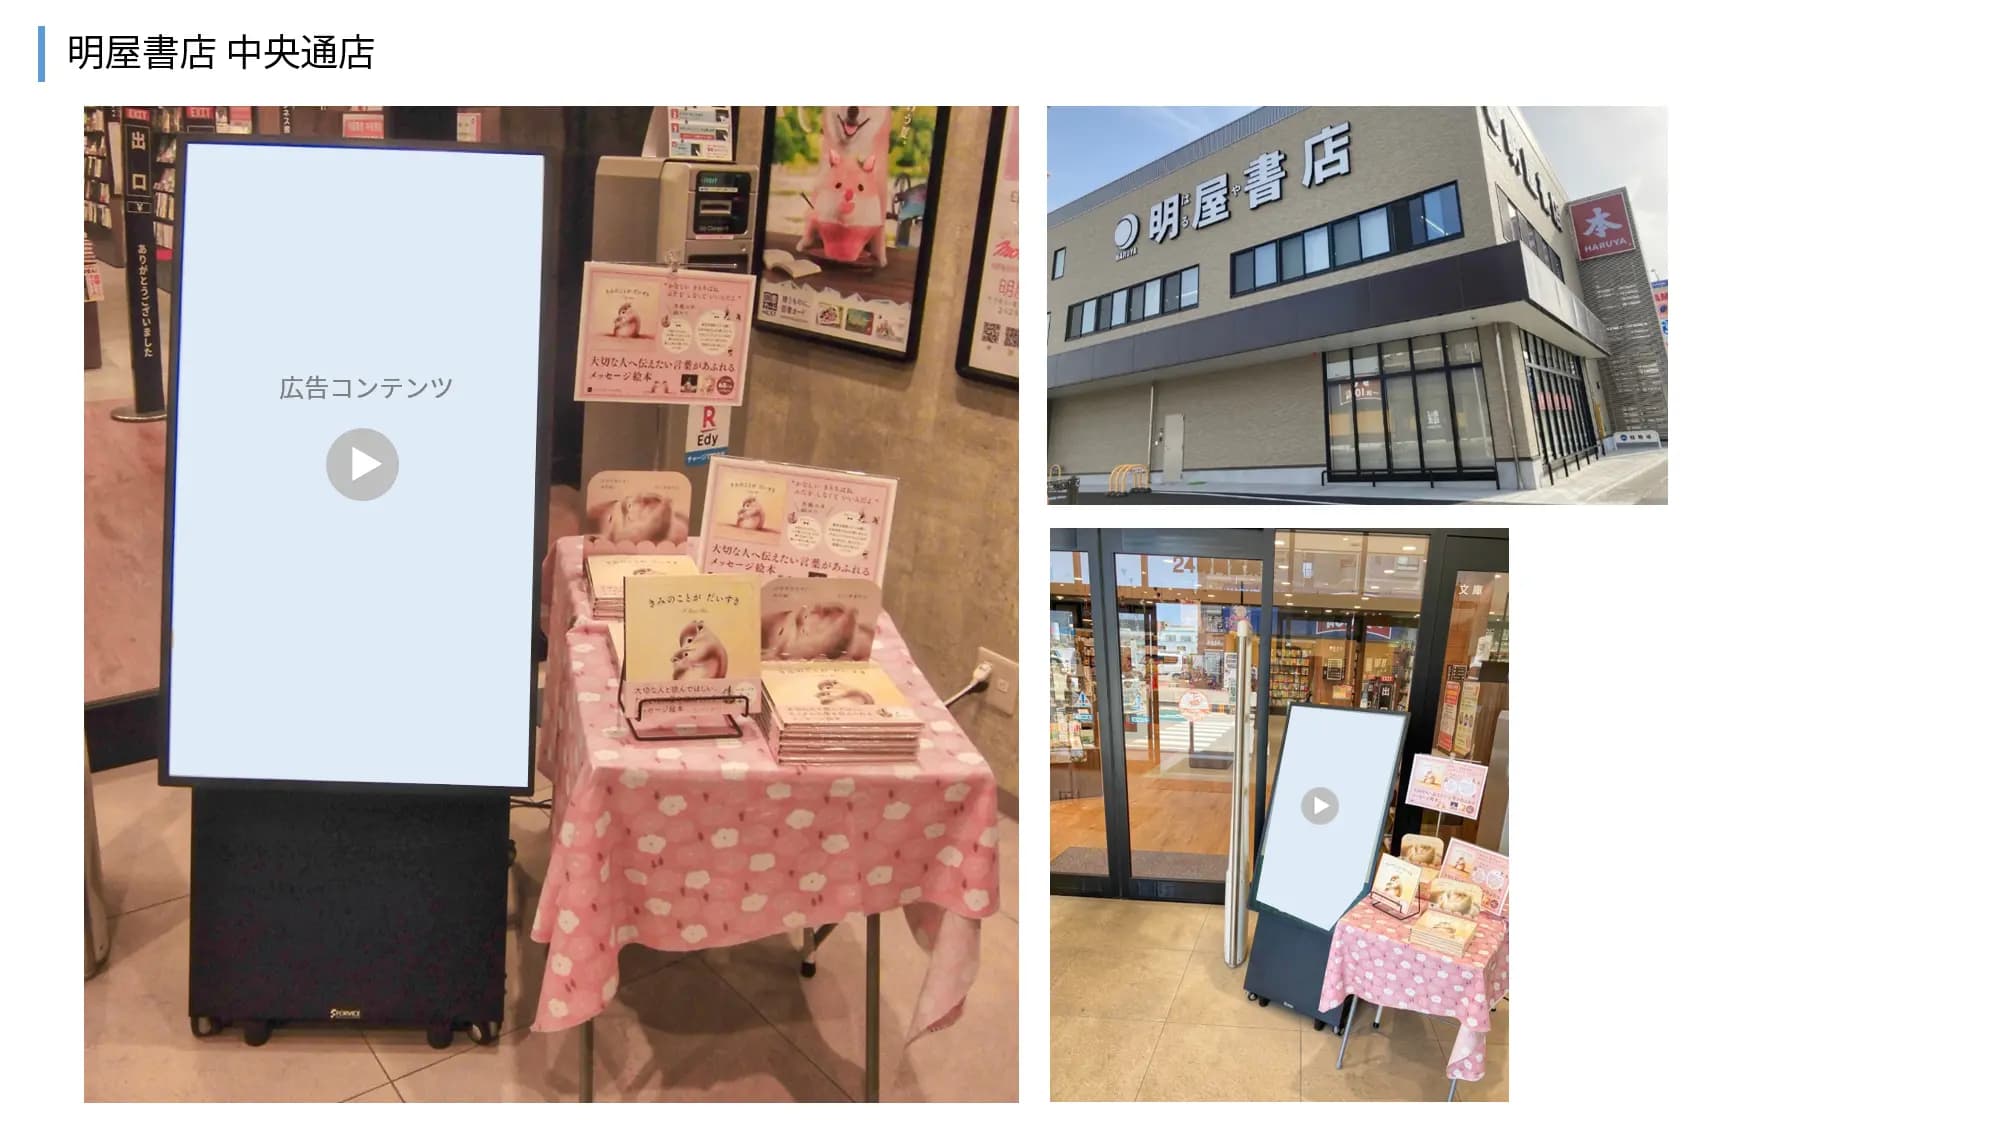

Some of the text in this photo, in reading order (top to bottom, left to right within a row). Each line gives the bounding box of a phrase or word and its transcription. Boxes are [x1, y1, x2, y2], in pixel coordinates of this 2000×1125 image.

[131, 130, 148, 191] 出口
[1149, 120, 1351, 244] 明屋書店
[1583, 207, 1623, 238] 本
[1584, 236, 1627, 254] HARUYA
[137, 243, 154, 358] ありがとうございました
[591, 355, 735, 373] 大切な人へ伝えたい言葉があふれる
[591, 371, 652, 382] メッセージ絵本
[702, 405, 716, 428] R
[697, 433, 718, 447] Edy
[711, 559, 776, 574] メッセージ絵本
[712, 543, 871, 576] 大切な人へ伝えたい言葉があふれる
[1459, 584, 1483, 596] 文庫
[649, 593, 740, 608] きみのことが だいすき
